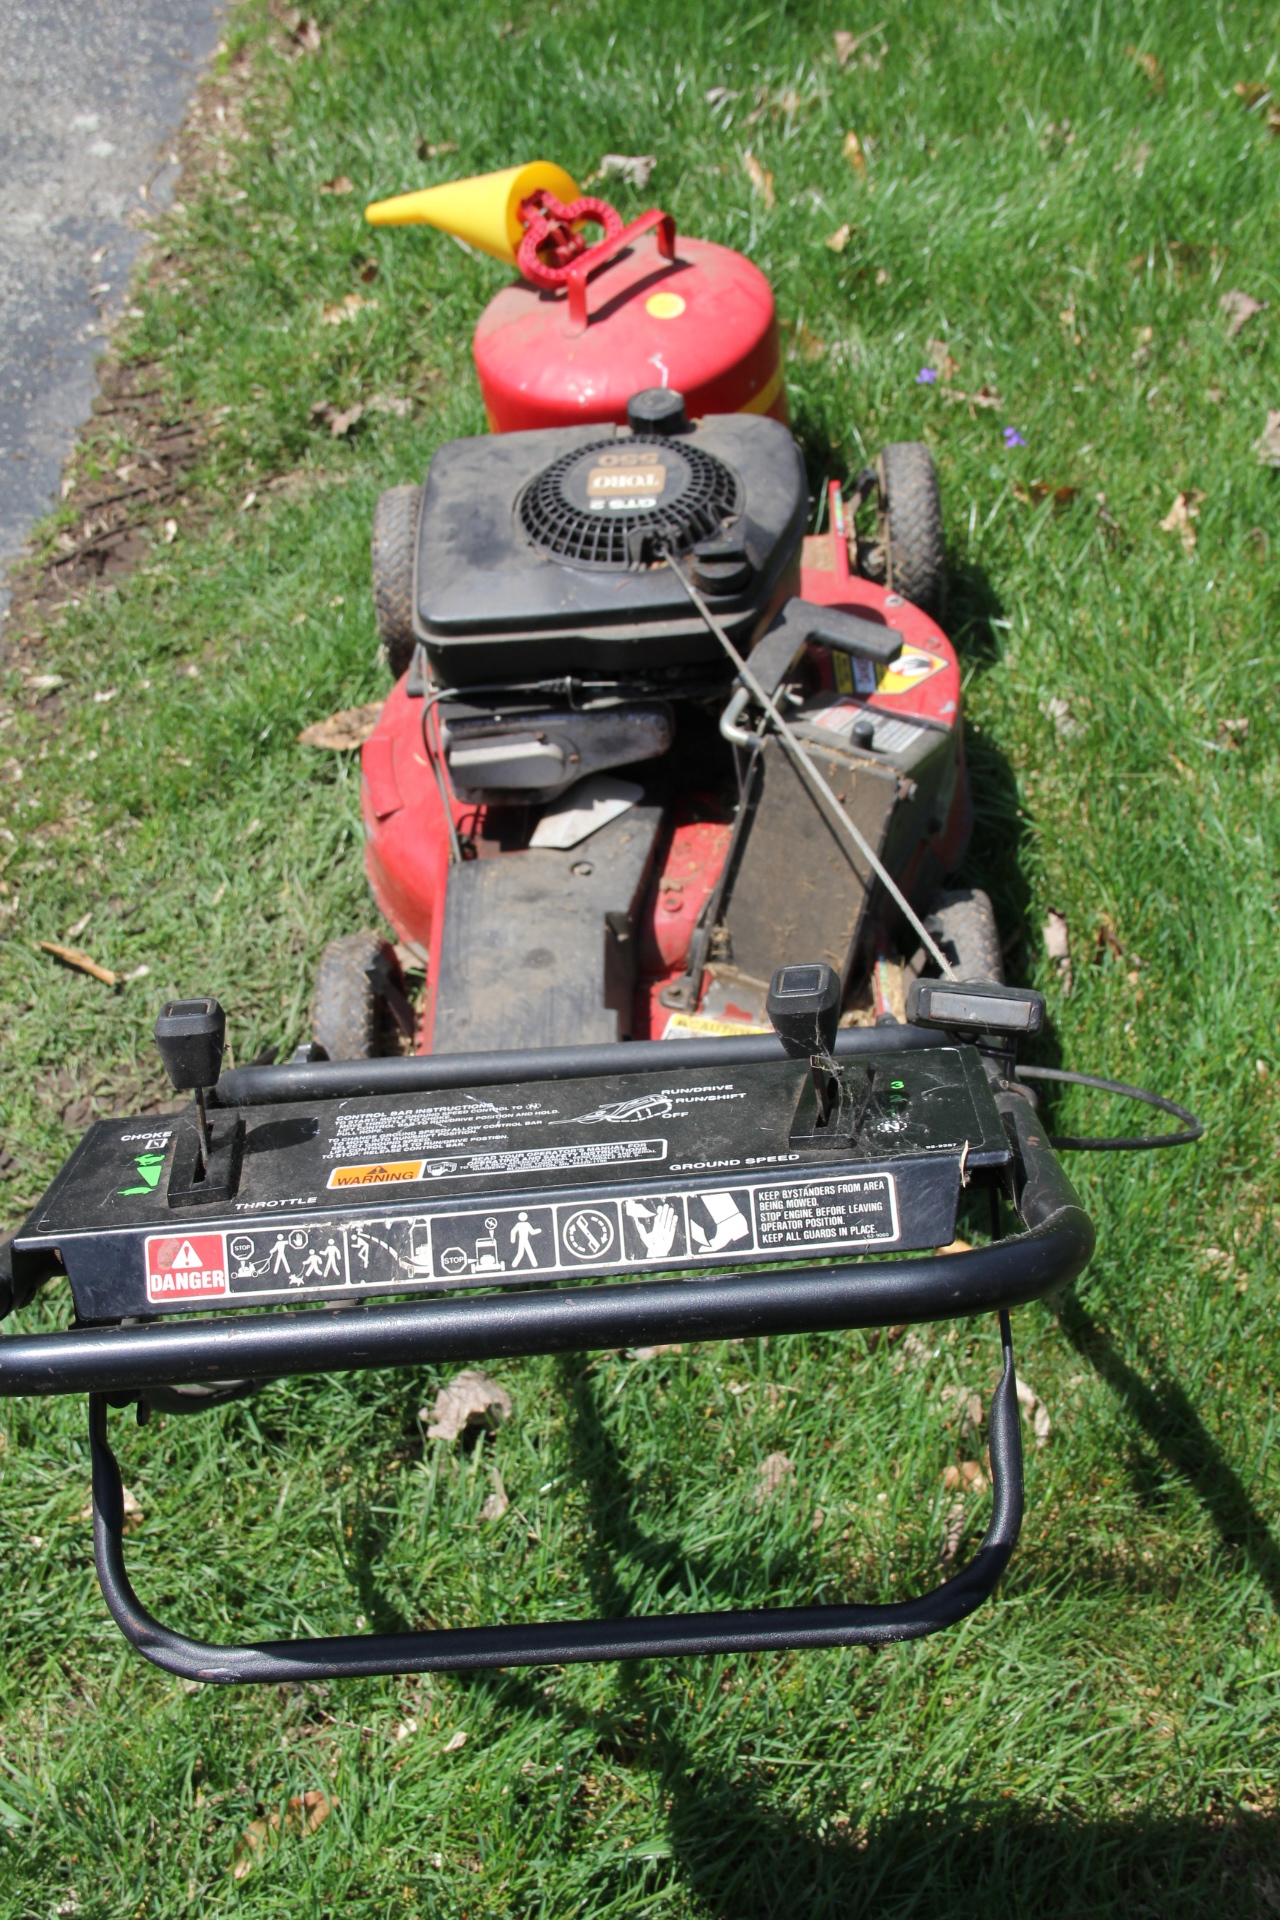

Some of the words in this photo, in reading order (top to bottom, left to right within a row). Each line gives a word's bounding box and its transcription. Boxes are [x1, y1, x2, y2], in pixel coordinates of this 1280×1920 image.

[592, 474, 659, 488] TORO
[661, 1084, 734, 1095] RUN/DRIVE
[890, 1080, 904, 1089] 3
[676, 1092, 746, 1103] RUN/SHIFT
[336, 1112, 386, 1120] CONTROL
[416, 1103, 493, 1114] INSTRUCTIONS
[121, 1131, 173, 1142] CHOKE
[669, 1160, 740, 1170] GROUND
[745, 1154, 800, 1165] SPEED
[338, 1172, 414, 1186] WARNING
[759, 1191, 779, 1201] KEEP
[782, 1185, 835, 1198] BYSTANDERS
[838, 1183, 860, 1194] FROM
[864, 1181, 884, 1191] AREA
[235, 1197, 318, 1210] THROTTLE
[760, 1200, 783, 1211] BEING
[787, 1198, 819, 1209] MOWED.
[761, 1211, 780, 1222] STOP
[784, 1208, 813, 1220] ENGINE
[816, 1206, 846, 1217] BEFORE
[849, 1202, 882, 1214] LEAVING
[761, 1220, 802, 1232] OPERATOR
[806, 1216, 845, 1228] POSITION.
[762, 1233, 783, 1243] KEEP
[786, 1231, 801, 1241] ALL
[804, 1228, 836, 1240] GUARDS
[839, 1227, 847, 1235] IN
[851, 1224, 877, 1235] PLACE.
[444, 1256, 464, 1264] STOP
[151, 1270, 225, 1292] DANGER
